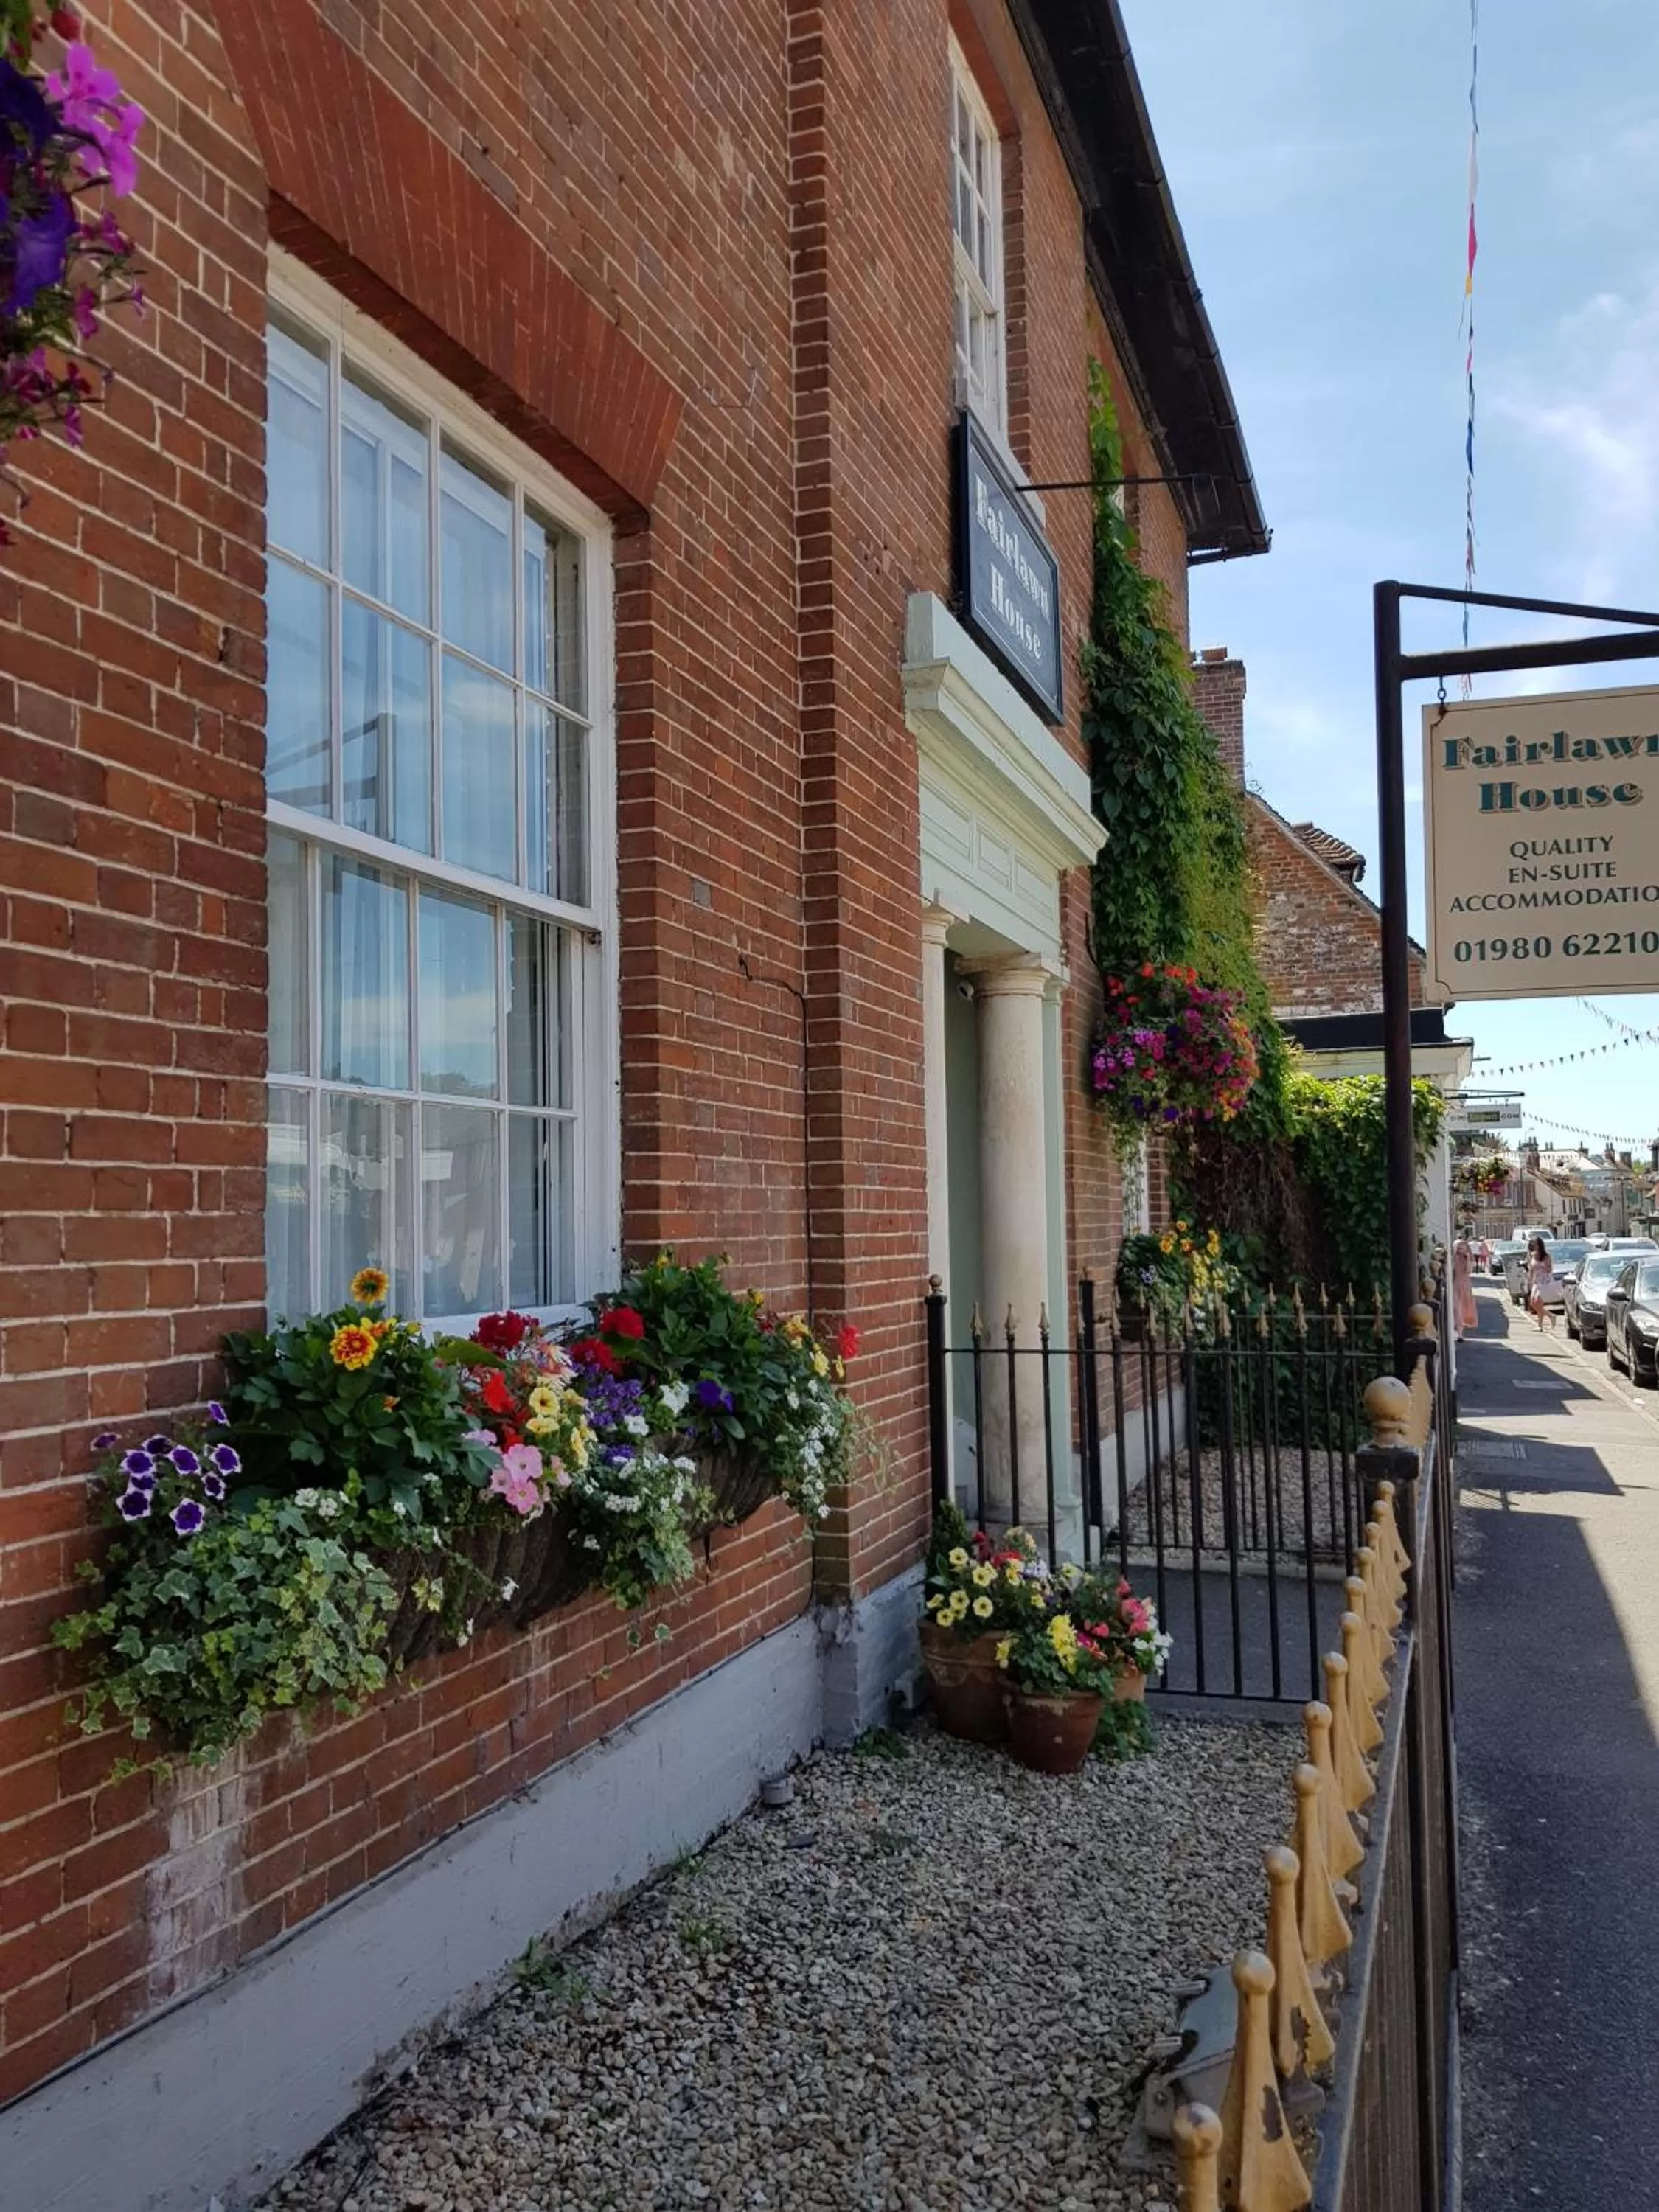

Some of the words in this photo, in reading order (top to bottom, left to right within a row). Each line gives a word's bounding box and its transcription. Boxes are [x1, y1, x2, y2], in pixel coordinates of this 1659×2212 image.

[976, 475, 1051, 619] Fairlawn
[990, 563, 1042, 661] House
[1478, 781, 1644, 813] House
[1510, 835, 1613, 860] QUALITY
[1509, 861, 1617, 883] EN-SUITE
[1455, 936, 1551, 962] 01980
[1562, 931, 1659, 956] 62210
